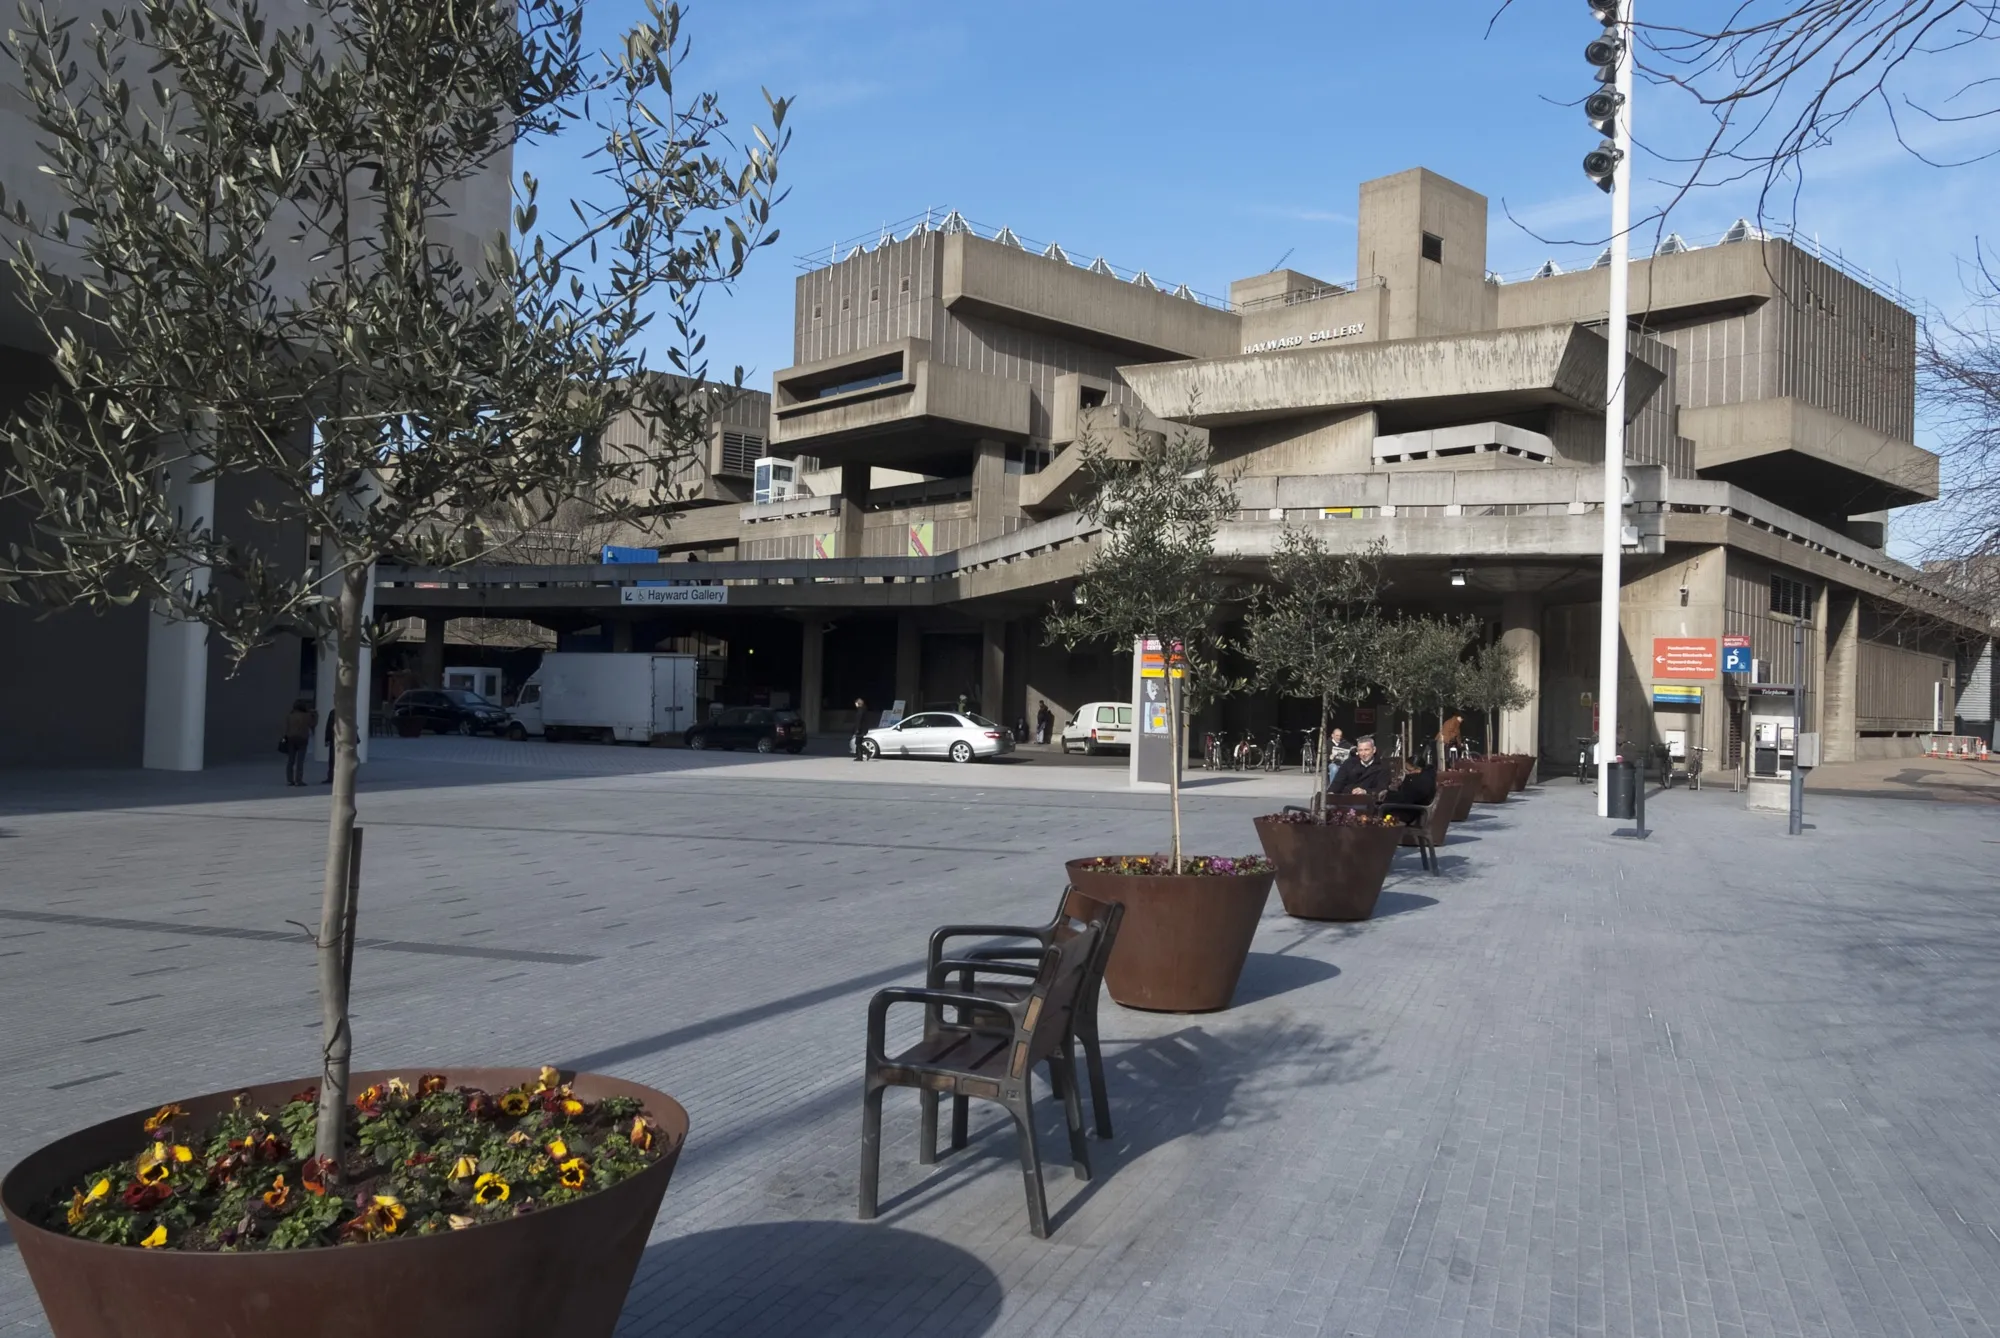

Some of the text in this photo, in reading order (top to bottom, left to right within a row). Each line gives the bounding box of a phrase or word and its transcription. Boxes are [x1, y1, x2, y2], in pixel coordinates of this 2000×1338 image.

[1243, 322, 1366, 354] HAYWARD GALLERY
[648, 589, 725, 603] Hayward Gallery
[1726, 655, 1739, 670] P
[1761, 688, 1789, 697] Telephone
